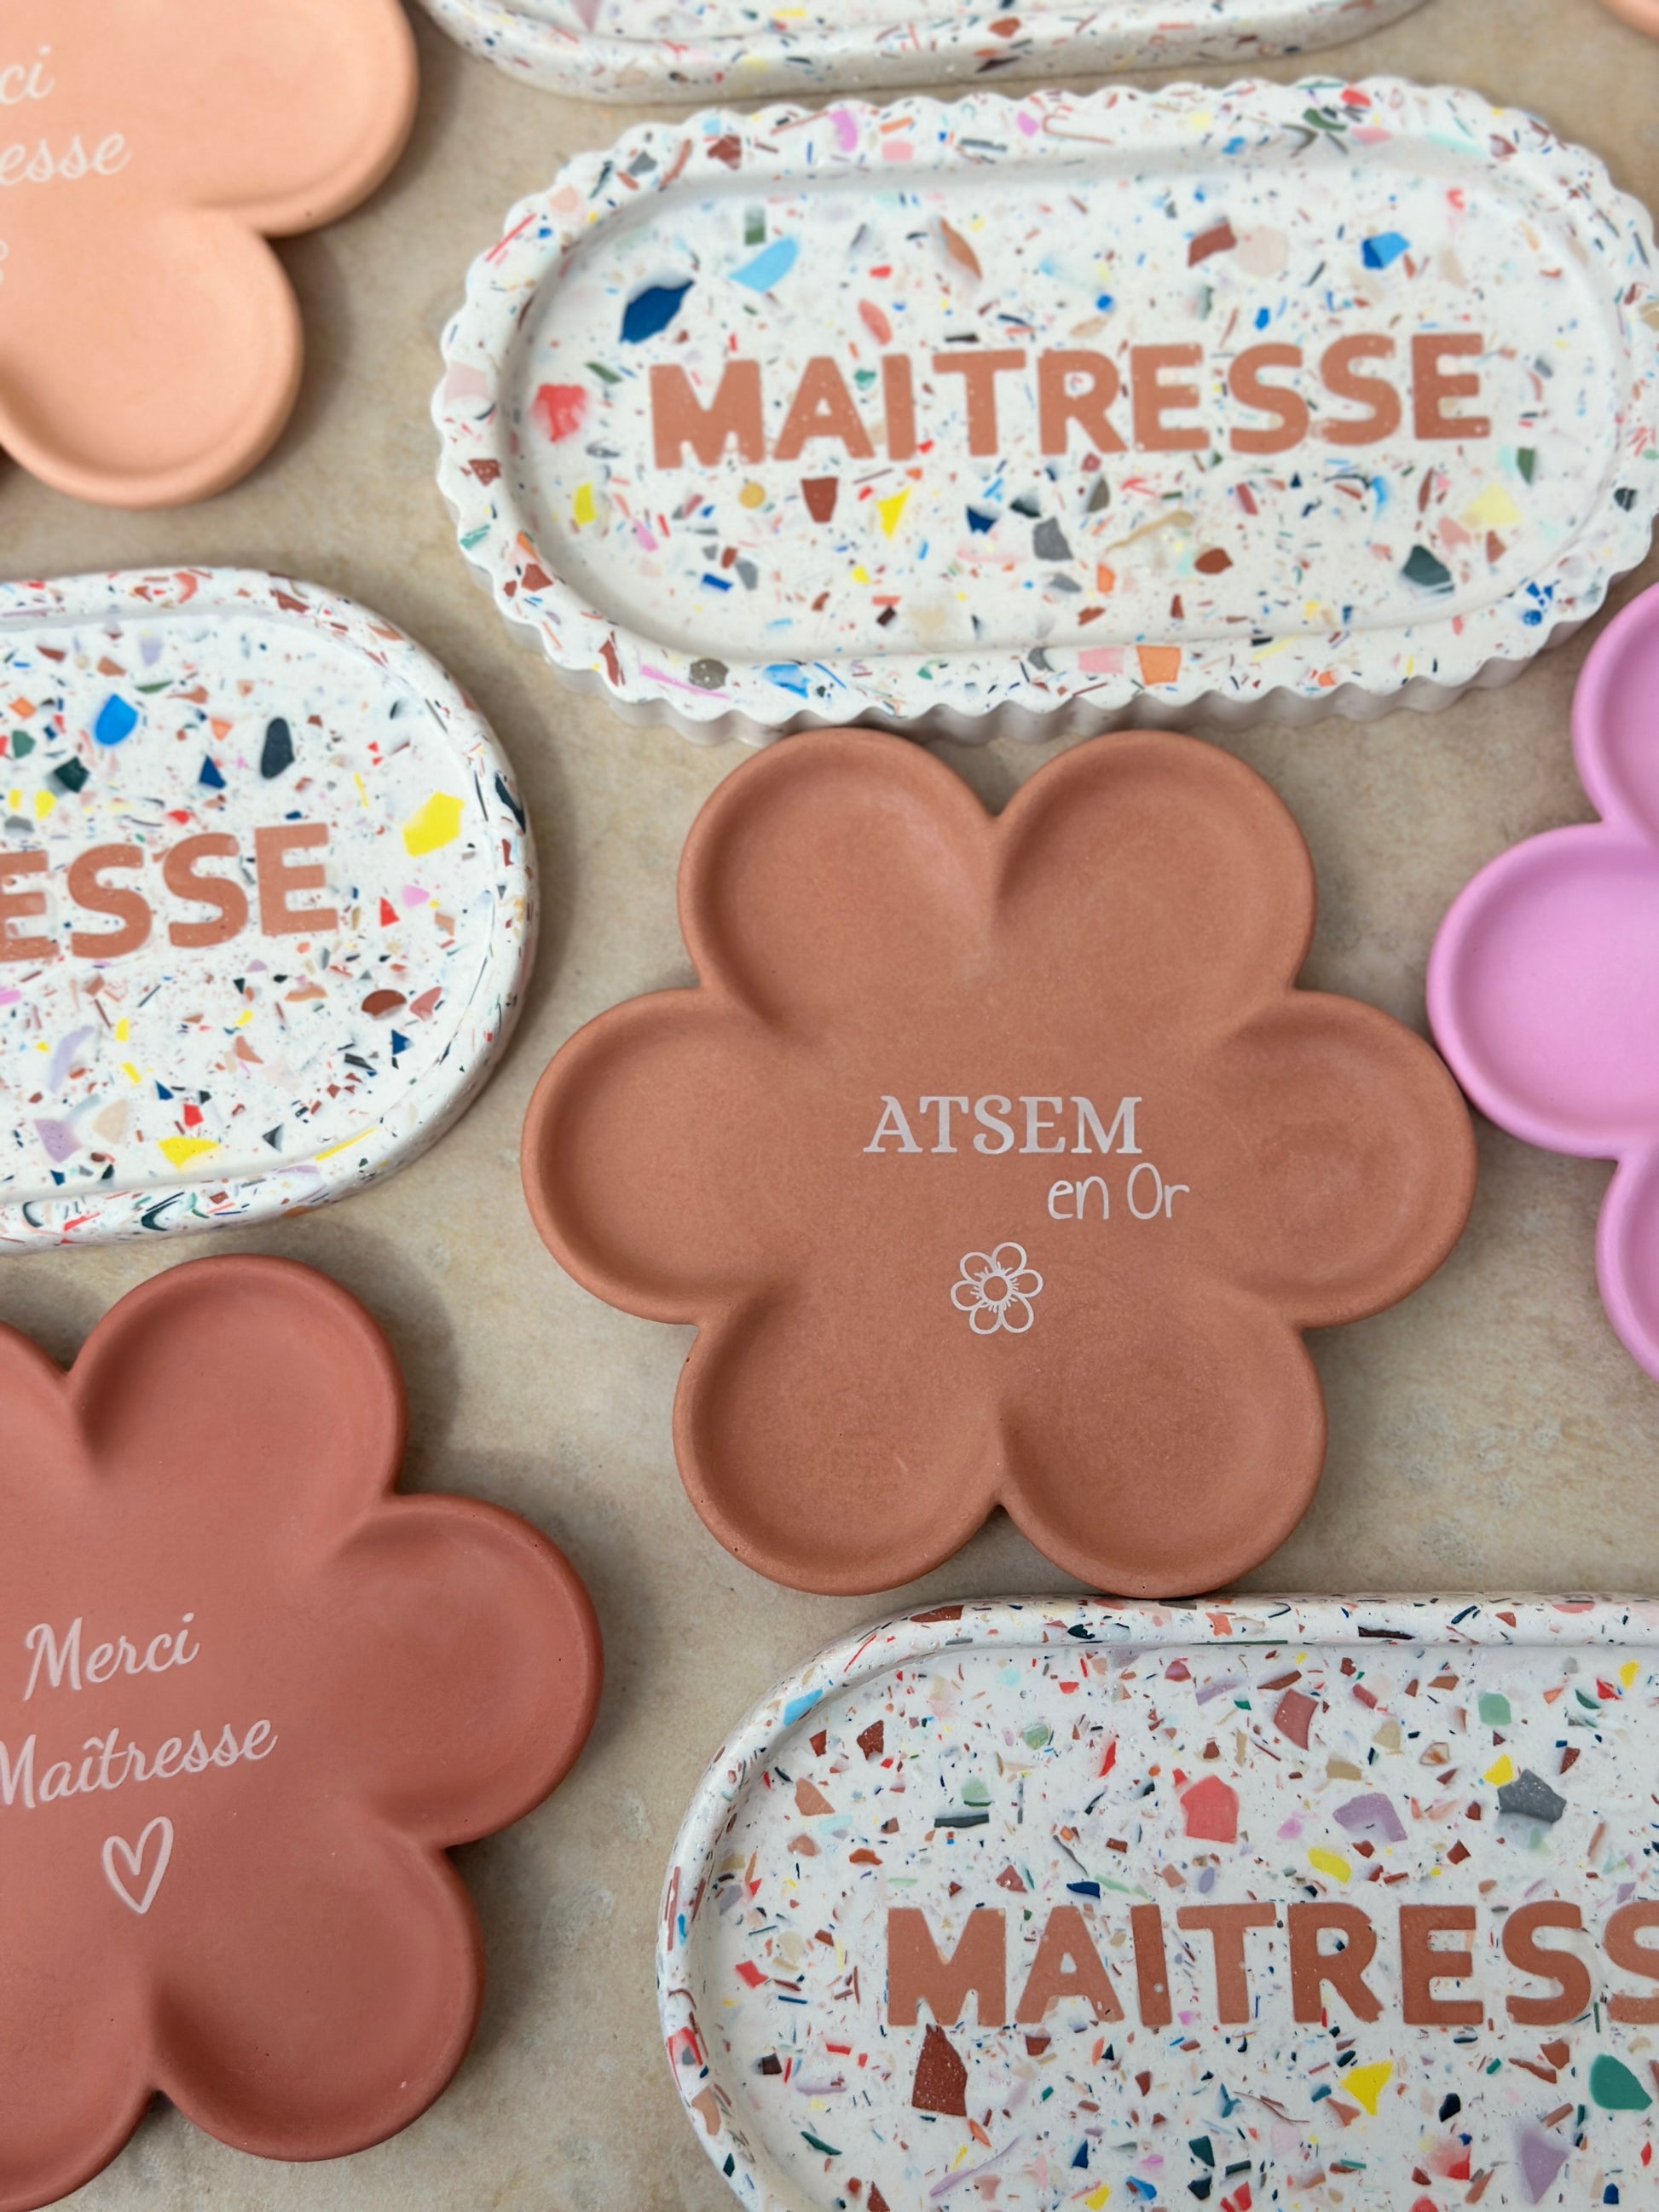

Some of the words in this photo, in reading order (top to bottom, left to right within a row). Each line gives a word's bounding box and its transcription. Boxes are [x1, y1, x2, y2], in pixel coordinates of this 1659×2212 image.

[649, 333, 1490, 469] MAITRESSE
[0, 823, 338, 962] ESSE
[863, 1094, 1142, 1155] ATSEM
[1048, 1175, 1109, 1220] en
[1127, 1163, 1190, 1220] Or
[23, 1612, 200, 1701] Merci
